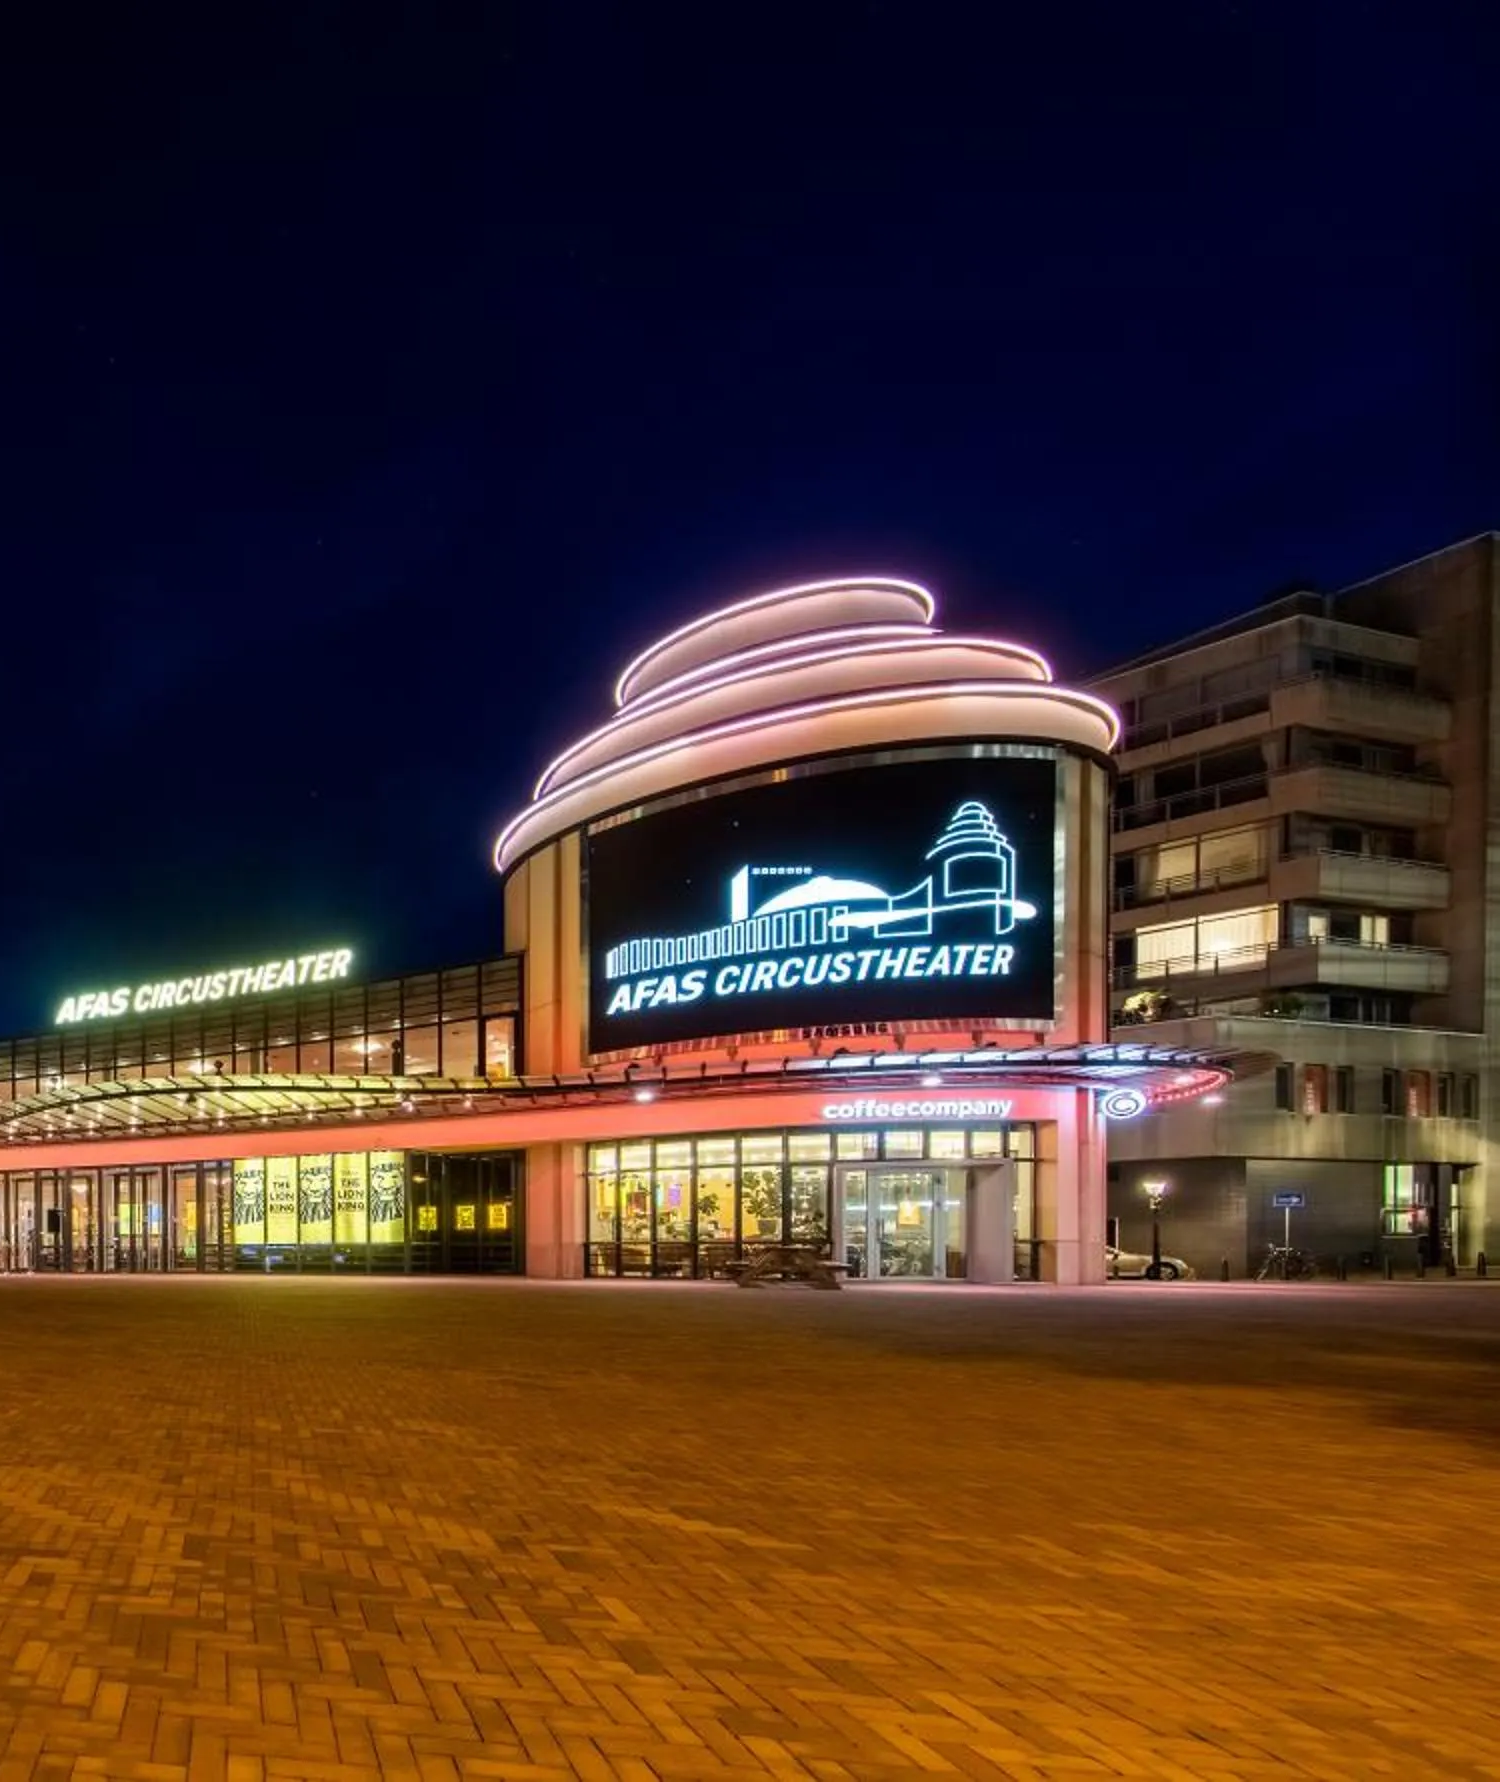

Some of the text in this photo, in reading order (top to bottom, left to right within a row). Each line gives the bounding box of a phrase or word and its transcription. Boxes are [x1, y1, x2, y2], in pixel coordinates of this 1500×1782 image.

[607, 944, 1015, 1015] AFAS CIRCUSTHEATER
[55, 948, 353, 1024] AFAS CIRCUSTHEATER
[802, 1022, 889, 1039] SAMSUNG
[823, 1099, 1013, 1118] coffeecompany
[272, 1181, 290, 1190] THE
[341, 1178, 360, 1188] THE
[269, 1192, 294, 1201] LION
[337, 1190, 364, 1199] LION
[269, 1203, 294, 1213] KING
[337, 1202, 364, 1212] KING
